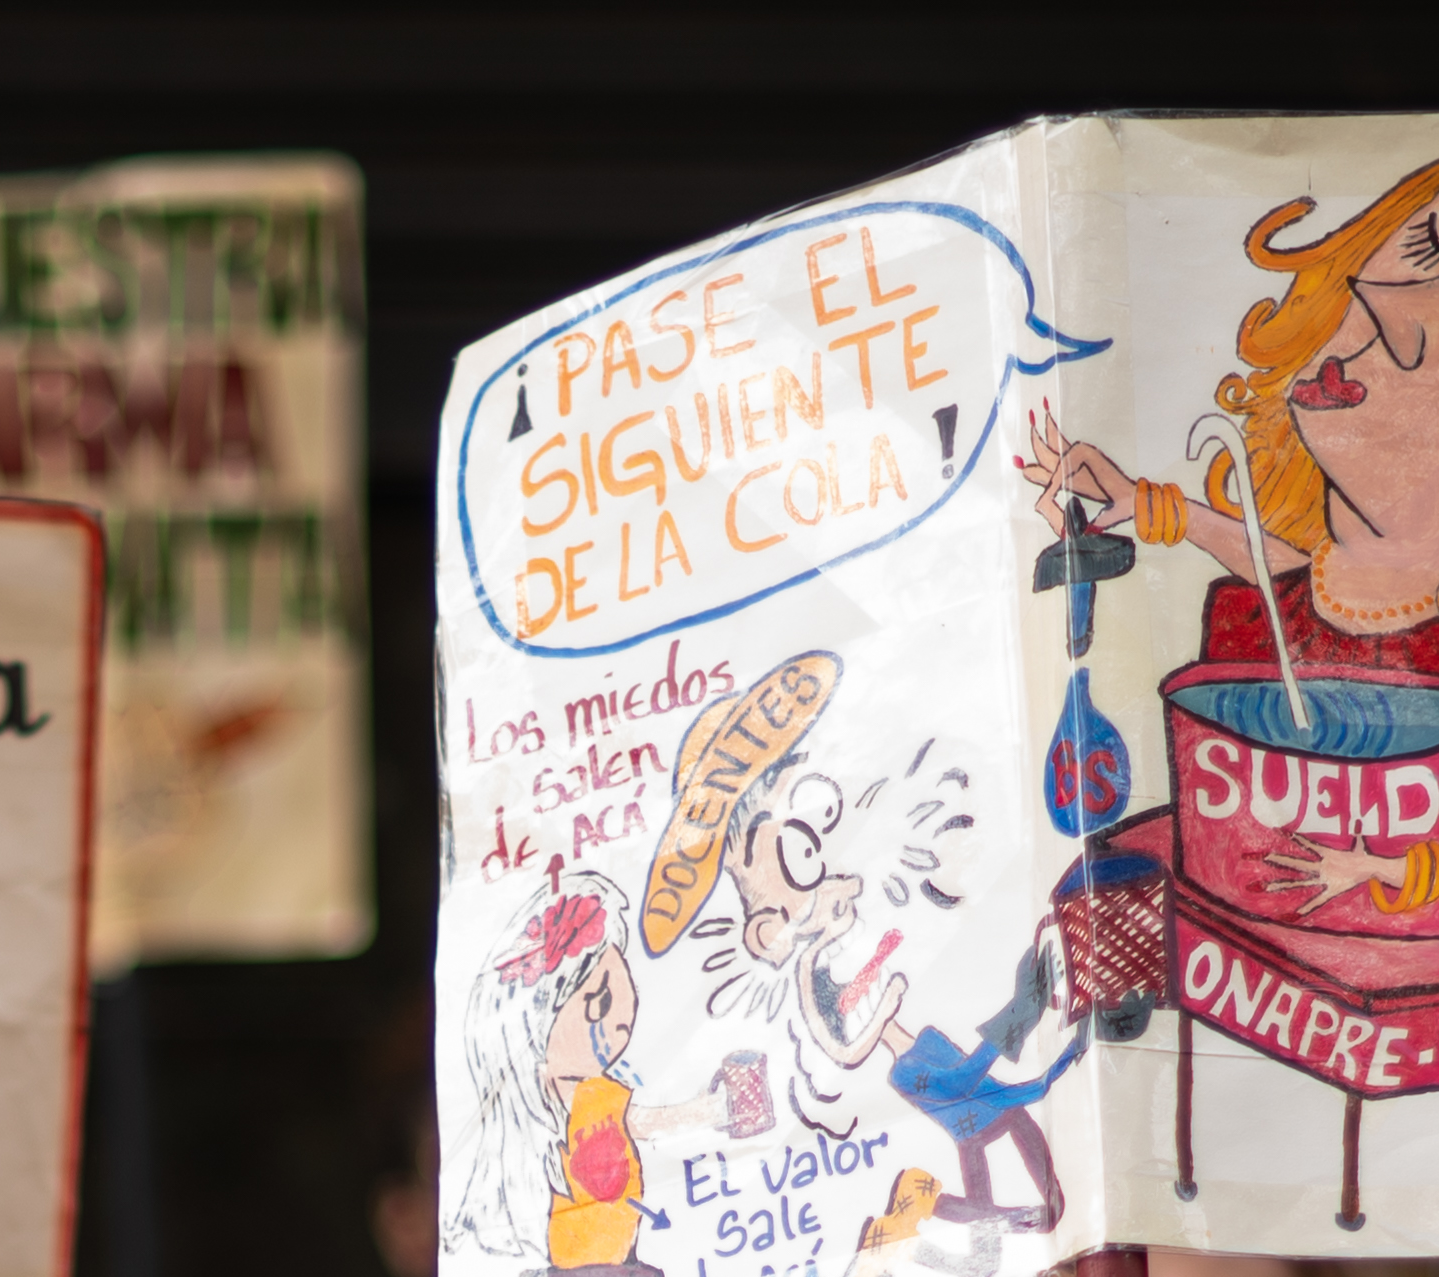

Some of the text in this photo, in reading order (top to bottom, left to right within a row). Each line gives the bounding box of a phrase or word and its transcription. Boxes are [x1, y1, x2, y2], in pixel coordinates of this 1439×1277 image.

[805, 226, 917, 327] EL
[521, 304, 950, 537] SIGUIENTE
[514, 540, 601, 640] DE
[620, 509, 694, 603] LA
[465, 697, 547, 764] Los
[645, 662, 824, 924] DOCENTES
